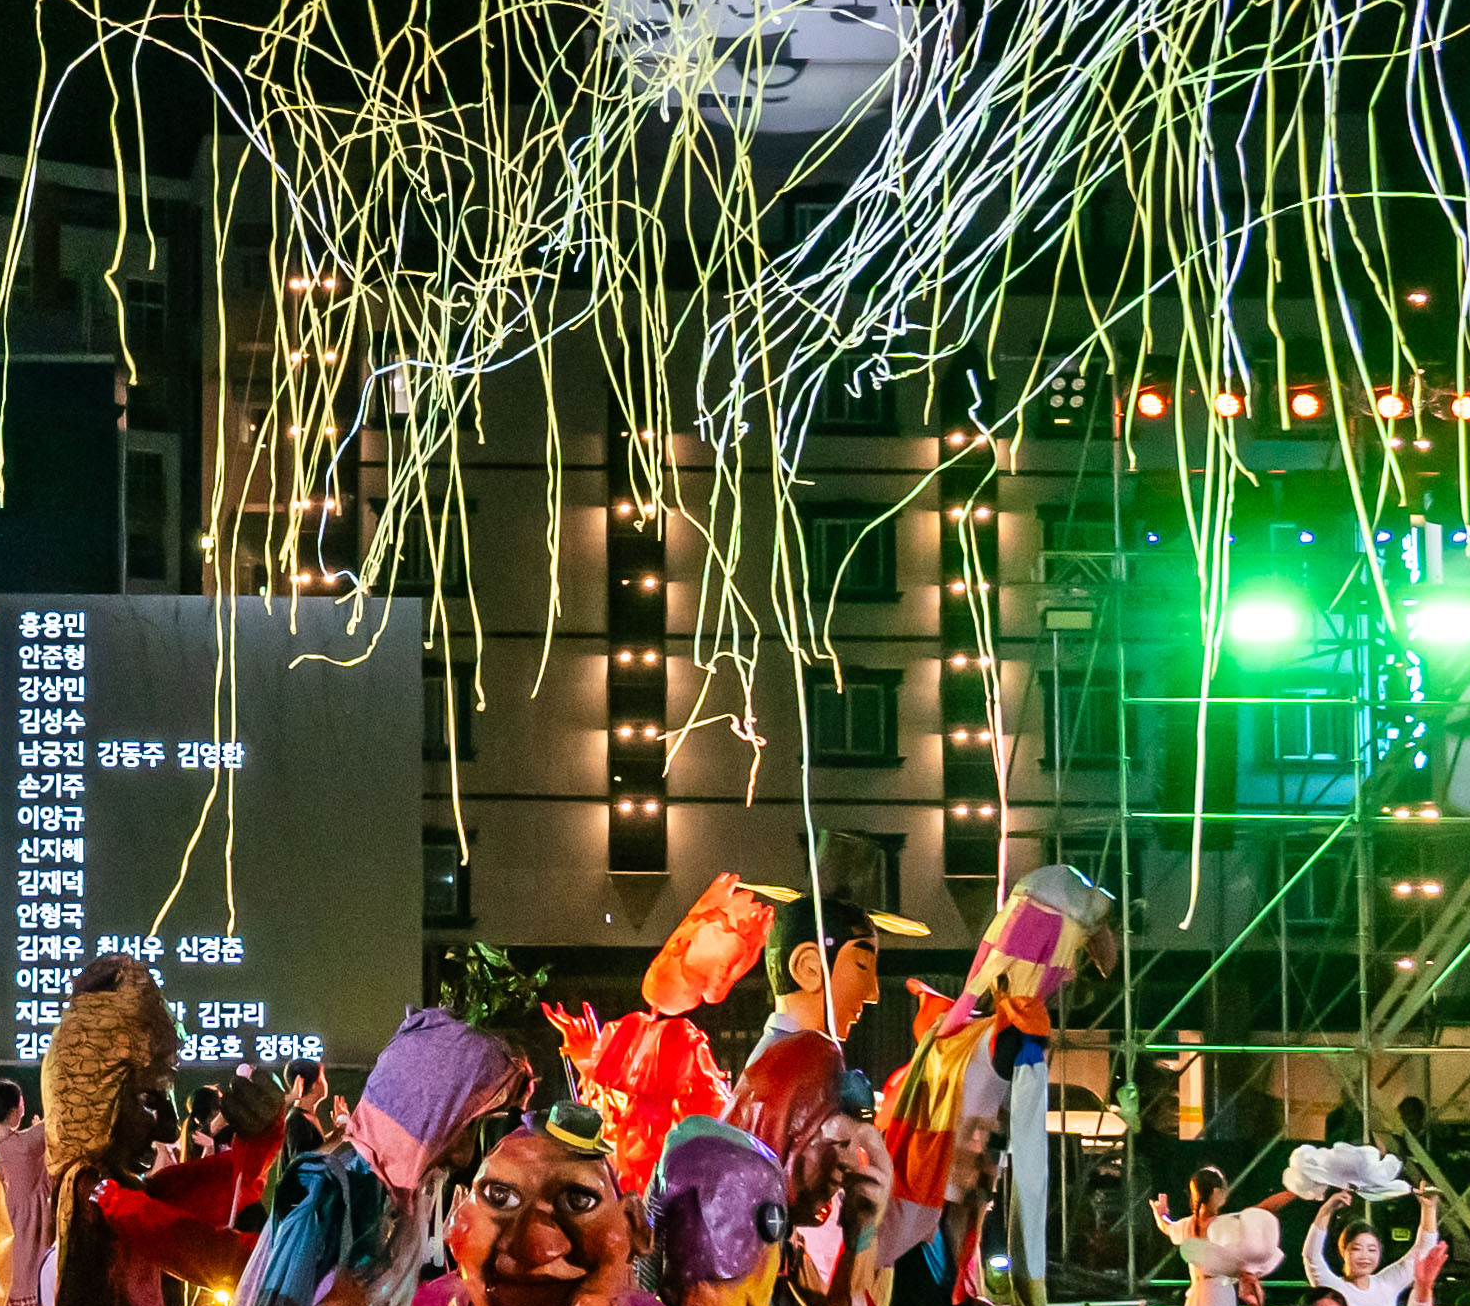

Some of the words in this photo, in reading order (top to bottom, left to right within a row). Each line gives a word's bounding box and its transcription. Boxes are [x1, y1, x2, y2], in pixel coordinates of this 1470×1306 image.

[18, 643, 85, 671] 안준형
[17, 675, 85, 703] 강상민
[18, 708, 86, 735] 김성수
[18, 740, 85, 767] 남궁진
[97, 741, 166, 768] 강동주
[177, 742, 245, 769] 김영환
[17, 772, 86, 800] 손기주
[17, 805, 85, 832] 이양규
[17, 837, 84, 864] 신지혜
[17, 869, 84, 898] 김재덕
[16, 901, 85, 930] 안형국
[16, 934, 85, 962] 김재우
[175, 935, 244, 964] 신경준
[198, 1001, 265, 1029] 김규리
[255, 1034, 324, 1062] 정하윤
